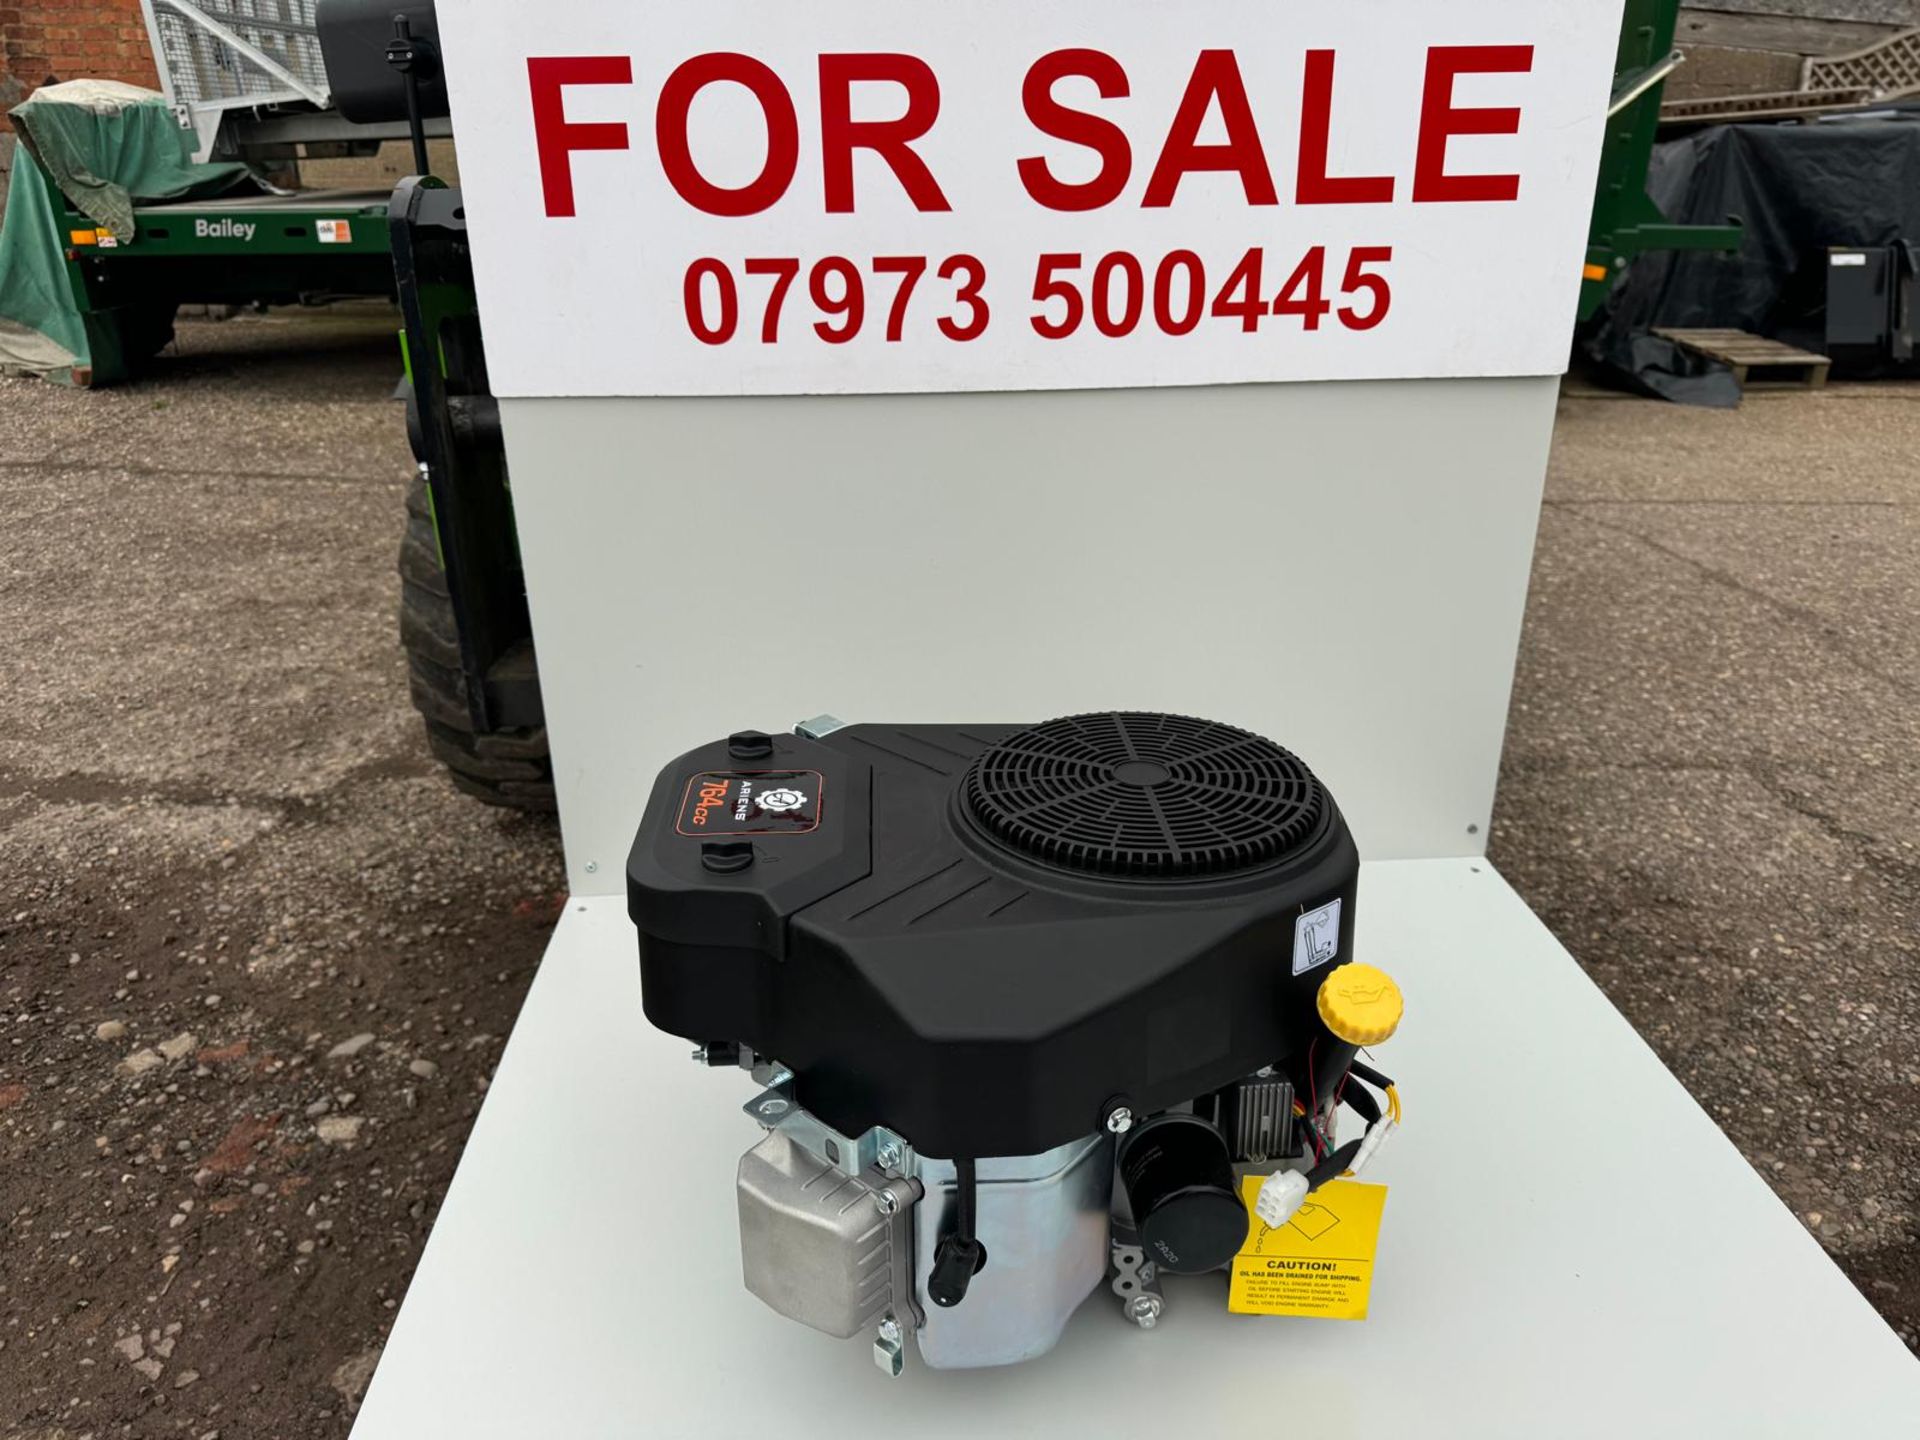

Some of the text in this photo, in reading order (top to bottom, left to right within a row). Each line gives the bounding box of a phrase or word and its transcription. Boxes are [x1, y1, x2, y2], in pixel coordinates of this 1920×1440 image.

[527, 45, 1534, 218] FOR SALE
[195, 218, 256, 241] Bailey
[683, 246, 1392, 345] 07973 500445
[735, 780, 752, 821] ARIENS
[1266, 1260, 1337, 1271] CAUTION!
